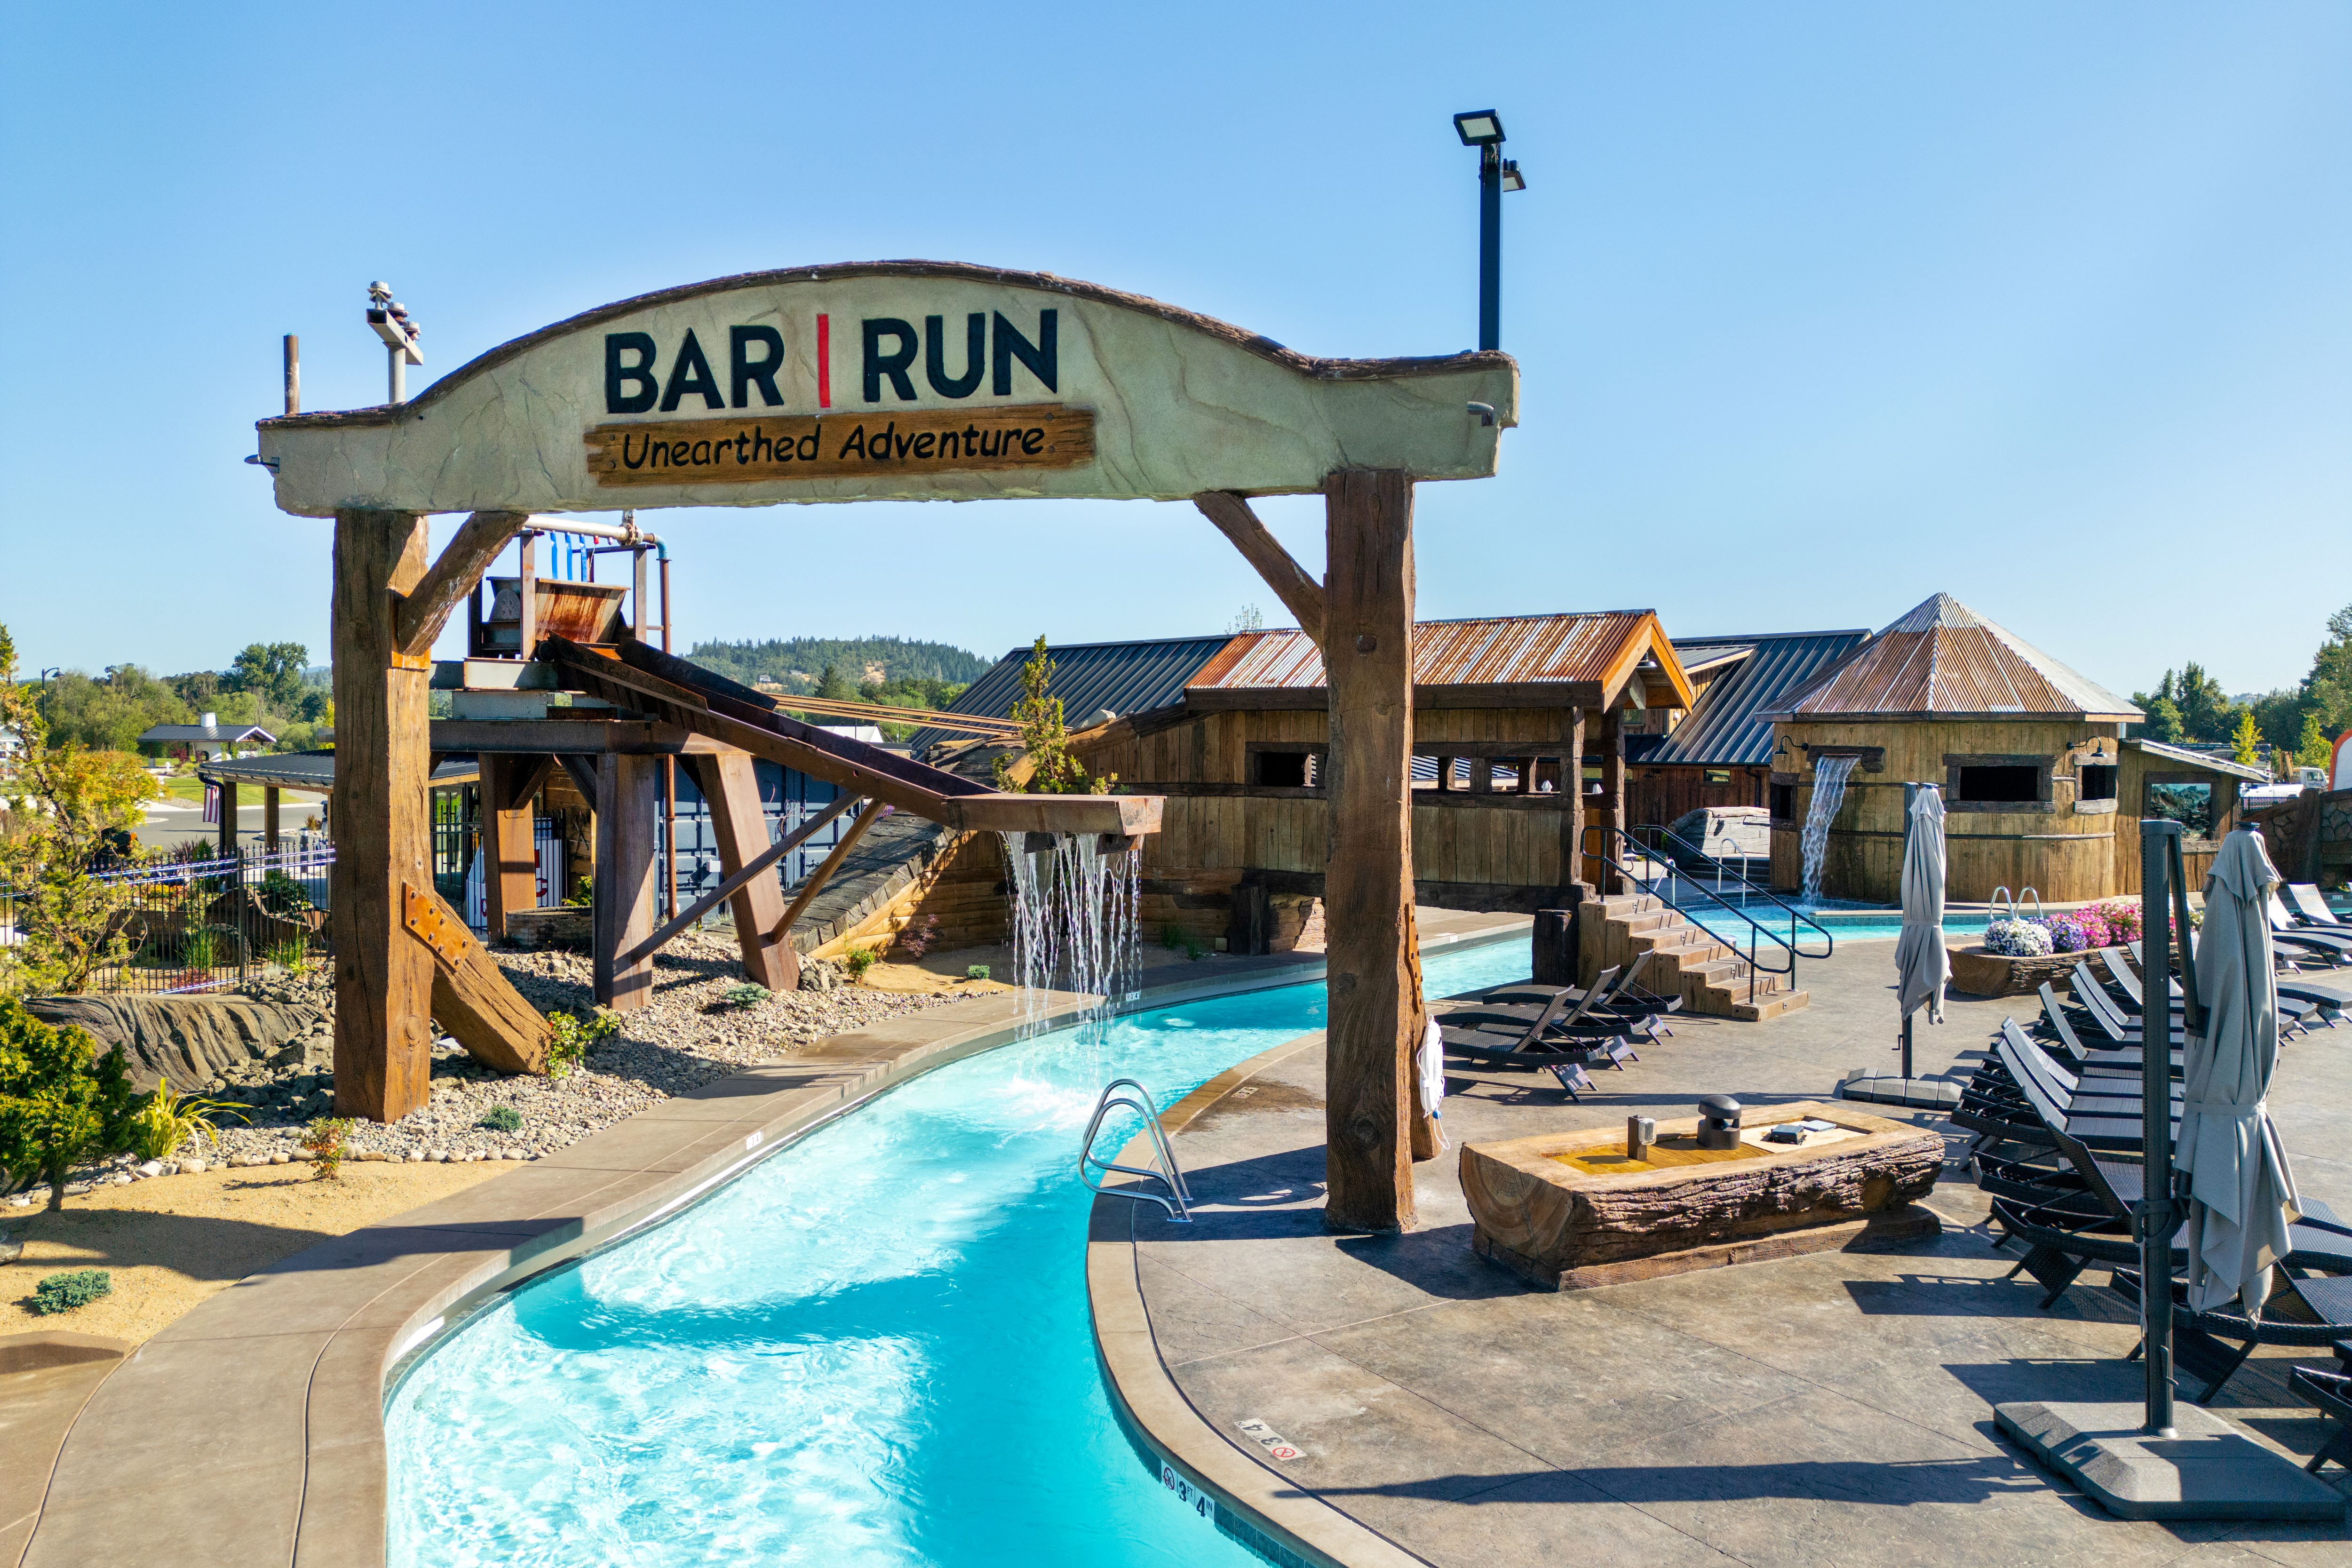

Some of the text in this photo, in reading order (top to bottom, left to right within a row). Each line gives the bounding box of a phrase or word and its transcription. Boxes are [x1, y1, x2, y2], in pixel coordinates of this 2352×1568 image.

[605, 325, 785, 414] BAR
[862, 309, 1058, 403] RUN
[622, 421, 1045, 470] Unearthed Adventure
[1178, 1480, 1213, 1518] 3 FT 4 IN
